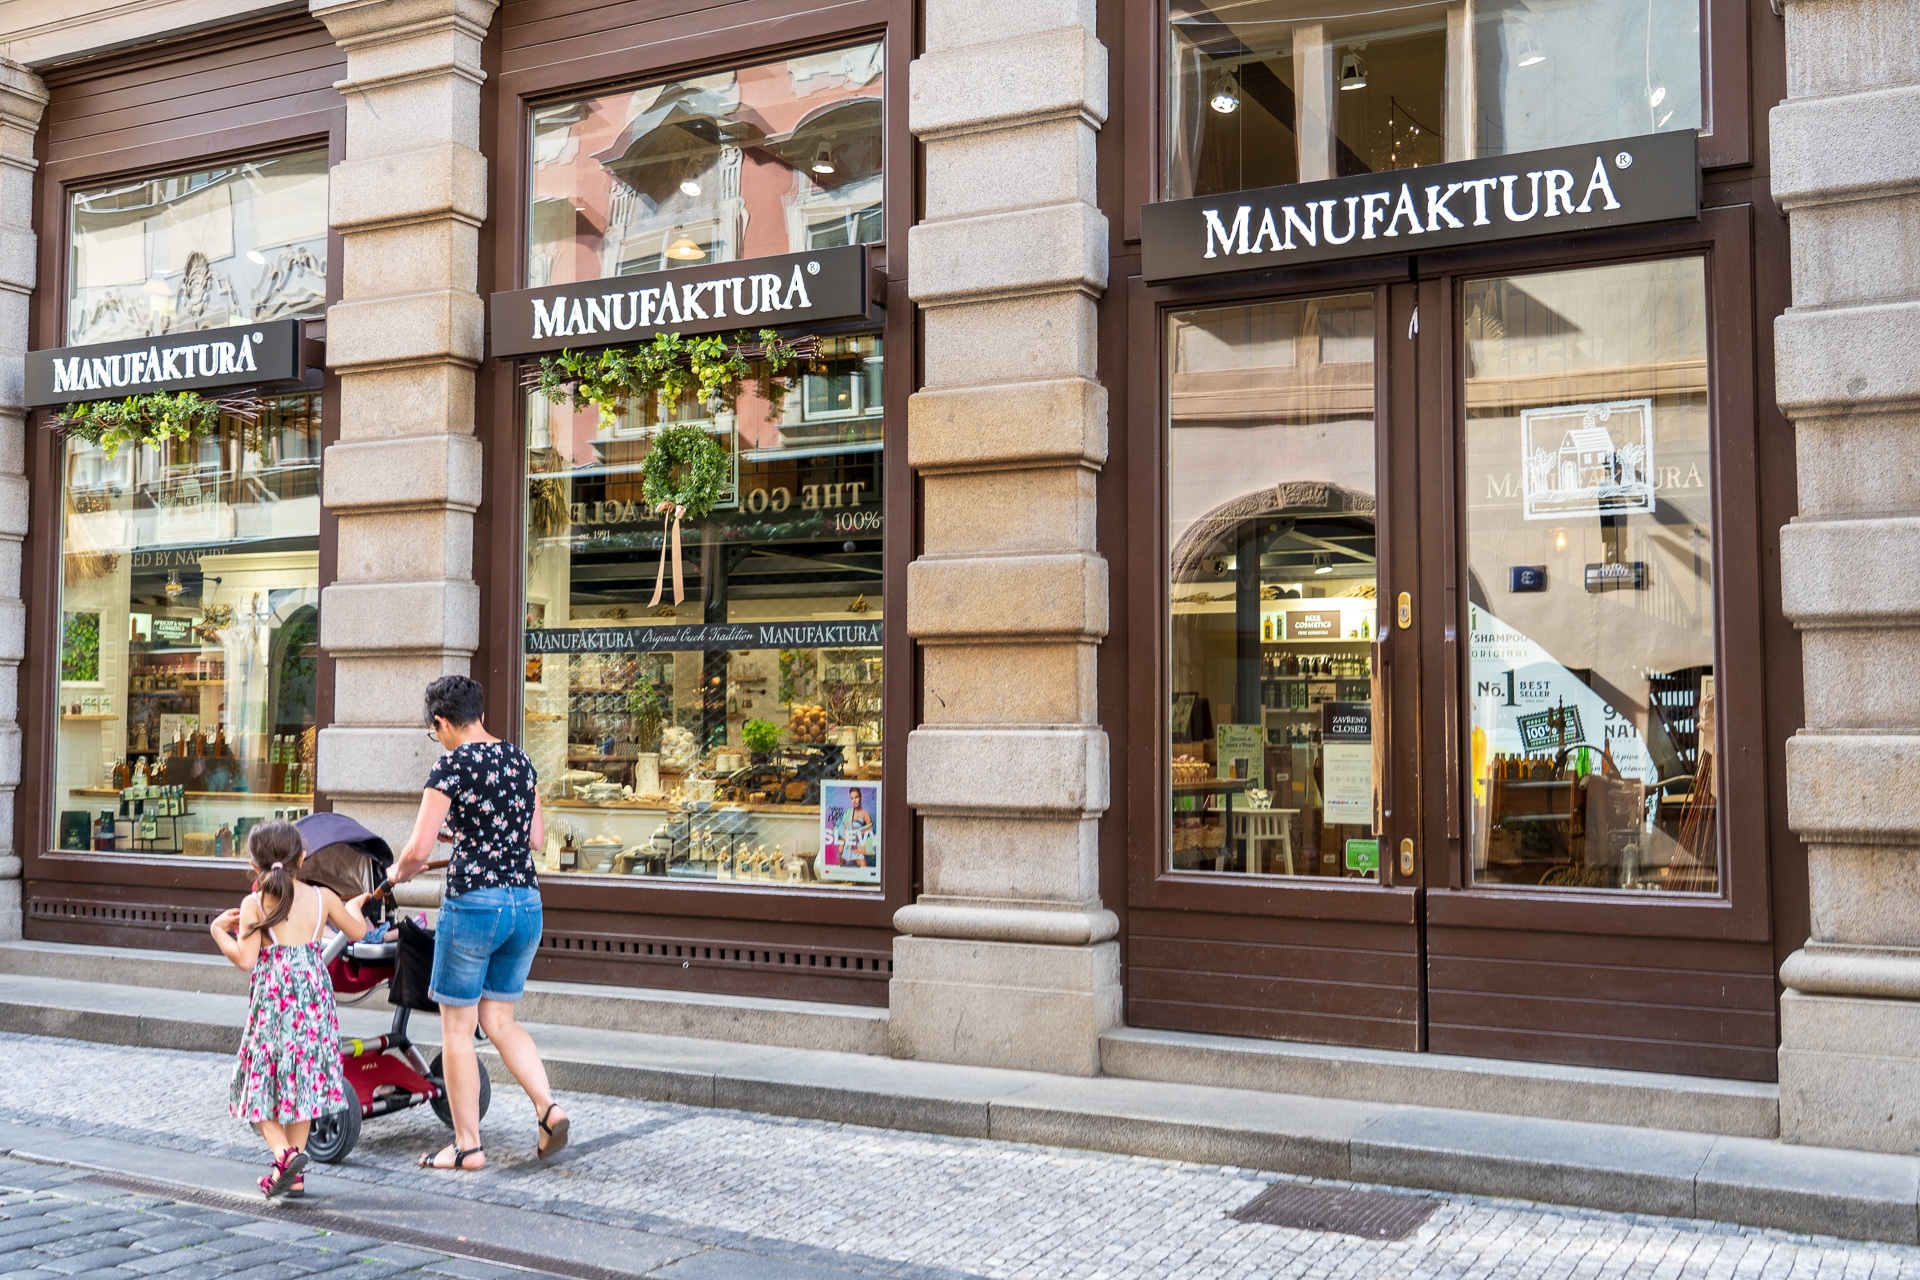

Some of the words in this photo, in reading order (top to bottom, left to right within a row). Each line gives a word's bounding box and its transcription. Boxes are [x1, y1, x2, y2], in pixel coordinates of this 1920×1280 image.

[835, 510, 881, 531] 100%
[593, 530, 611, 540] 1991
[155, 551, 172, 566] BY
[1294, 621, 1332, 629] COSMETICS
[641, 629, 680, 650] Original
[708, 624, 755, 642] Tradition
[1471, 650, 1528, 658] ORIGINAL
[1519, 681, 1551, 690] BEST
[1519, 690, 1550, 698] SELLER
[1332, 725, 1367, 734] CLOSED
